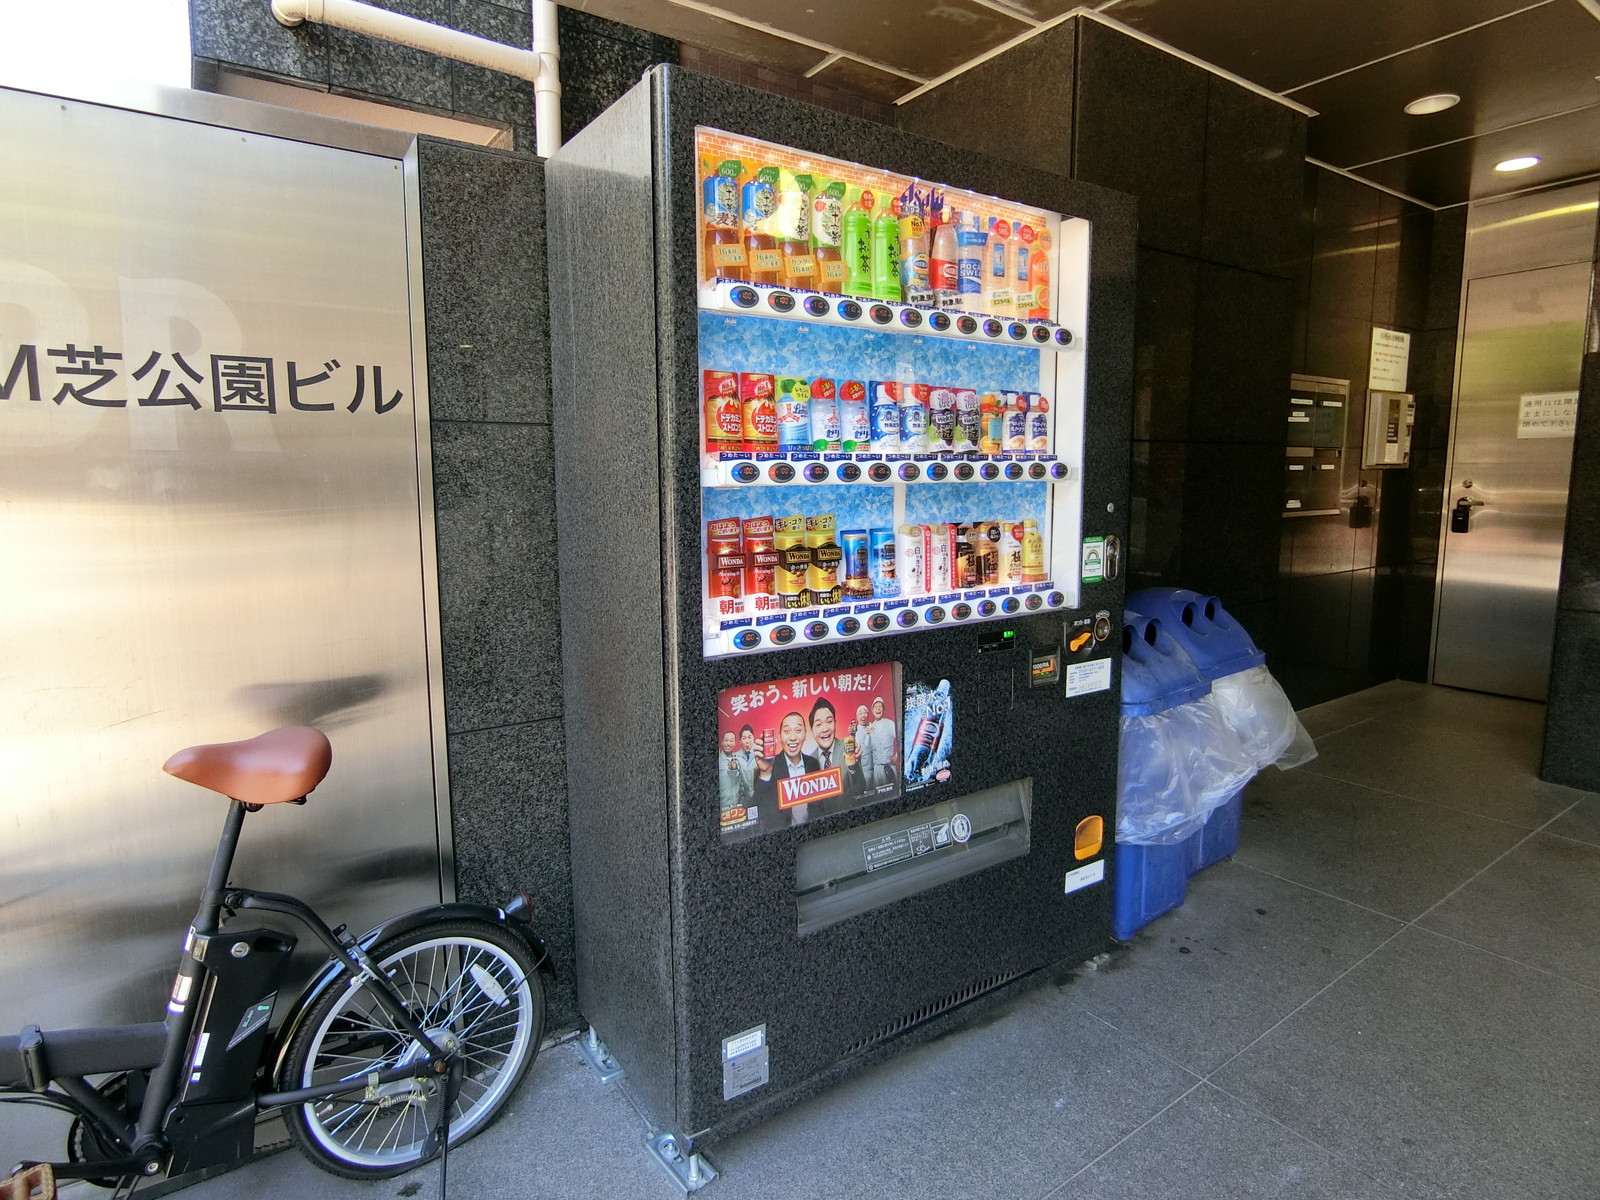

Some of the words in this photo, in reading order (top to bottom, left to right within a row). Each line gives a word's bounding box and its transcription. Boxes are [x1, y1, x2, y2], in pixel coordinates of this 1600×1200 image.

[900, 182, 944, 211] Asahi
[716, 212, 739, 228] 麦茶
[720, 556, 744, 566] WONDA
[756, 554, 779, 564] WONDA
[788, 551, 810, 561] WONDA
[820, 549, 841, 558] WONDA
[719, 599, 735, 615] 朝
[754, 596, 770, 611] 朝
[781, 774, 838, 801] WONDA
